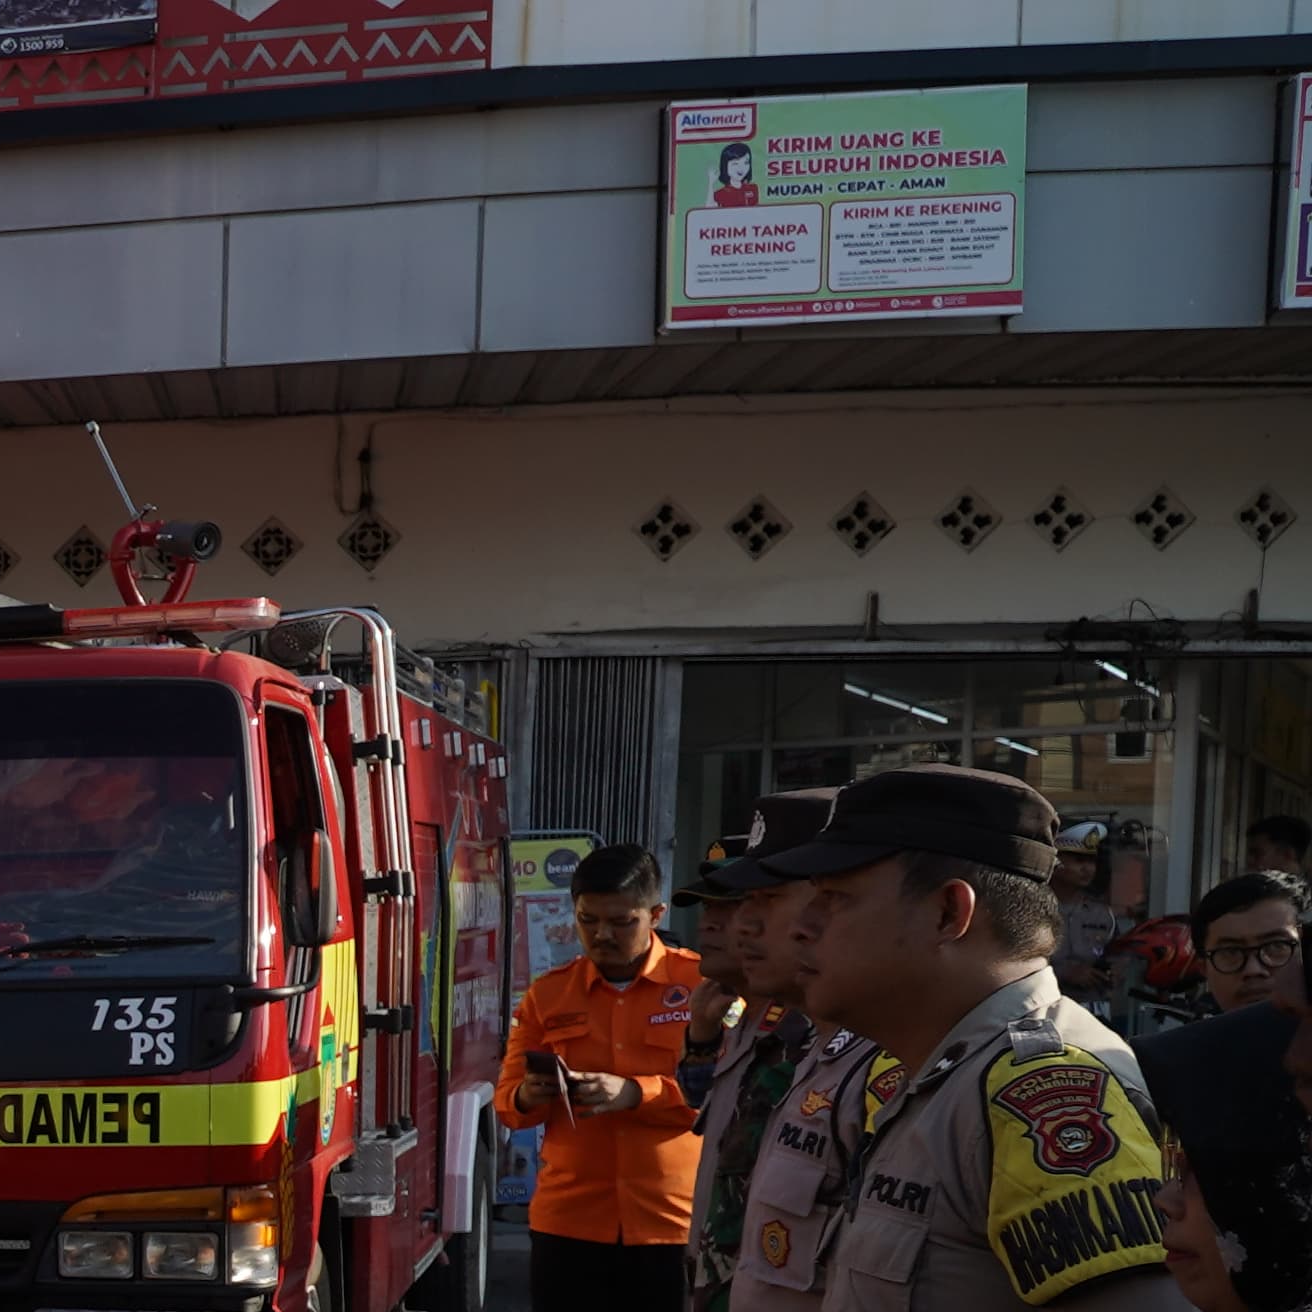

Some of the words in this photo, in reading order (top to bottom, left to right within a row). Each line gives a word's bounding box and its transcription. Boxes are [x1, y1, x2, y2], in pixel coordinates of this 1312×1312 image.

[45, 38, 65, 49] 959
[681, 112, 746, 126] Alfamart
[767, 136, 832, 154] KIRIM
[840, 132, 904, 150] UANG
[912, 130, 942, 146] KE
[767, 156, 871, 177] SELURUH
[879, 150, 1007, 171] INDONESIA
[767, 182, 823, 197] MUDAH
[838, 180, 886, 193] CEPAT
[900, 177, 946, 191] AMAN
[843, 207, 889, 220] KIRIM
[894, 205, 915, 217] KE
[920, 201, 1003, 216] REKENING
[699, 226, 747, 240] KIRIM
[752, 223, 809, 237] TANPA
[711, 241, 796, 256] REKENING
[91, 996, 178, 1032] 135
[650, 1009, 693, 1025] RESCU
[129, 1032, 176, 1066] PS
[1008, 1070, 1096, 1099] POLRES
[778, 1122, 827, 1158] POLRI
[867, 1174, 931, 1215] POLRI
